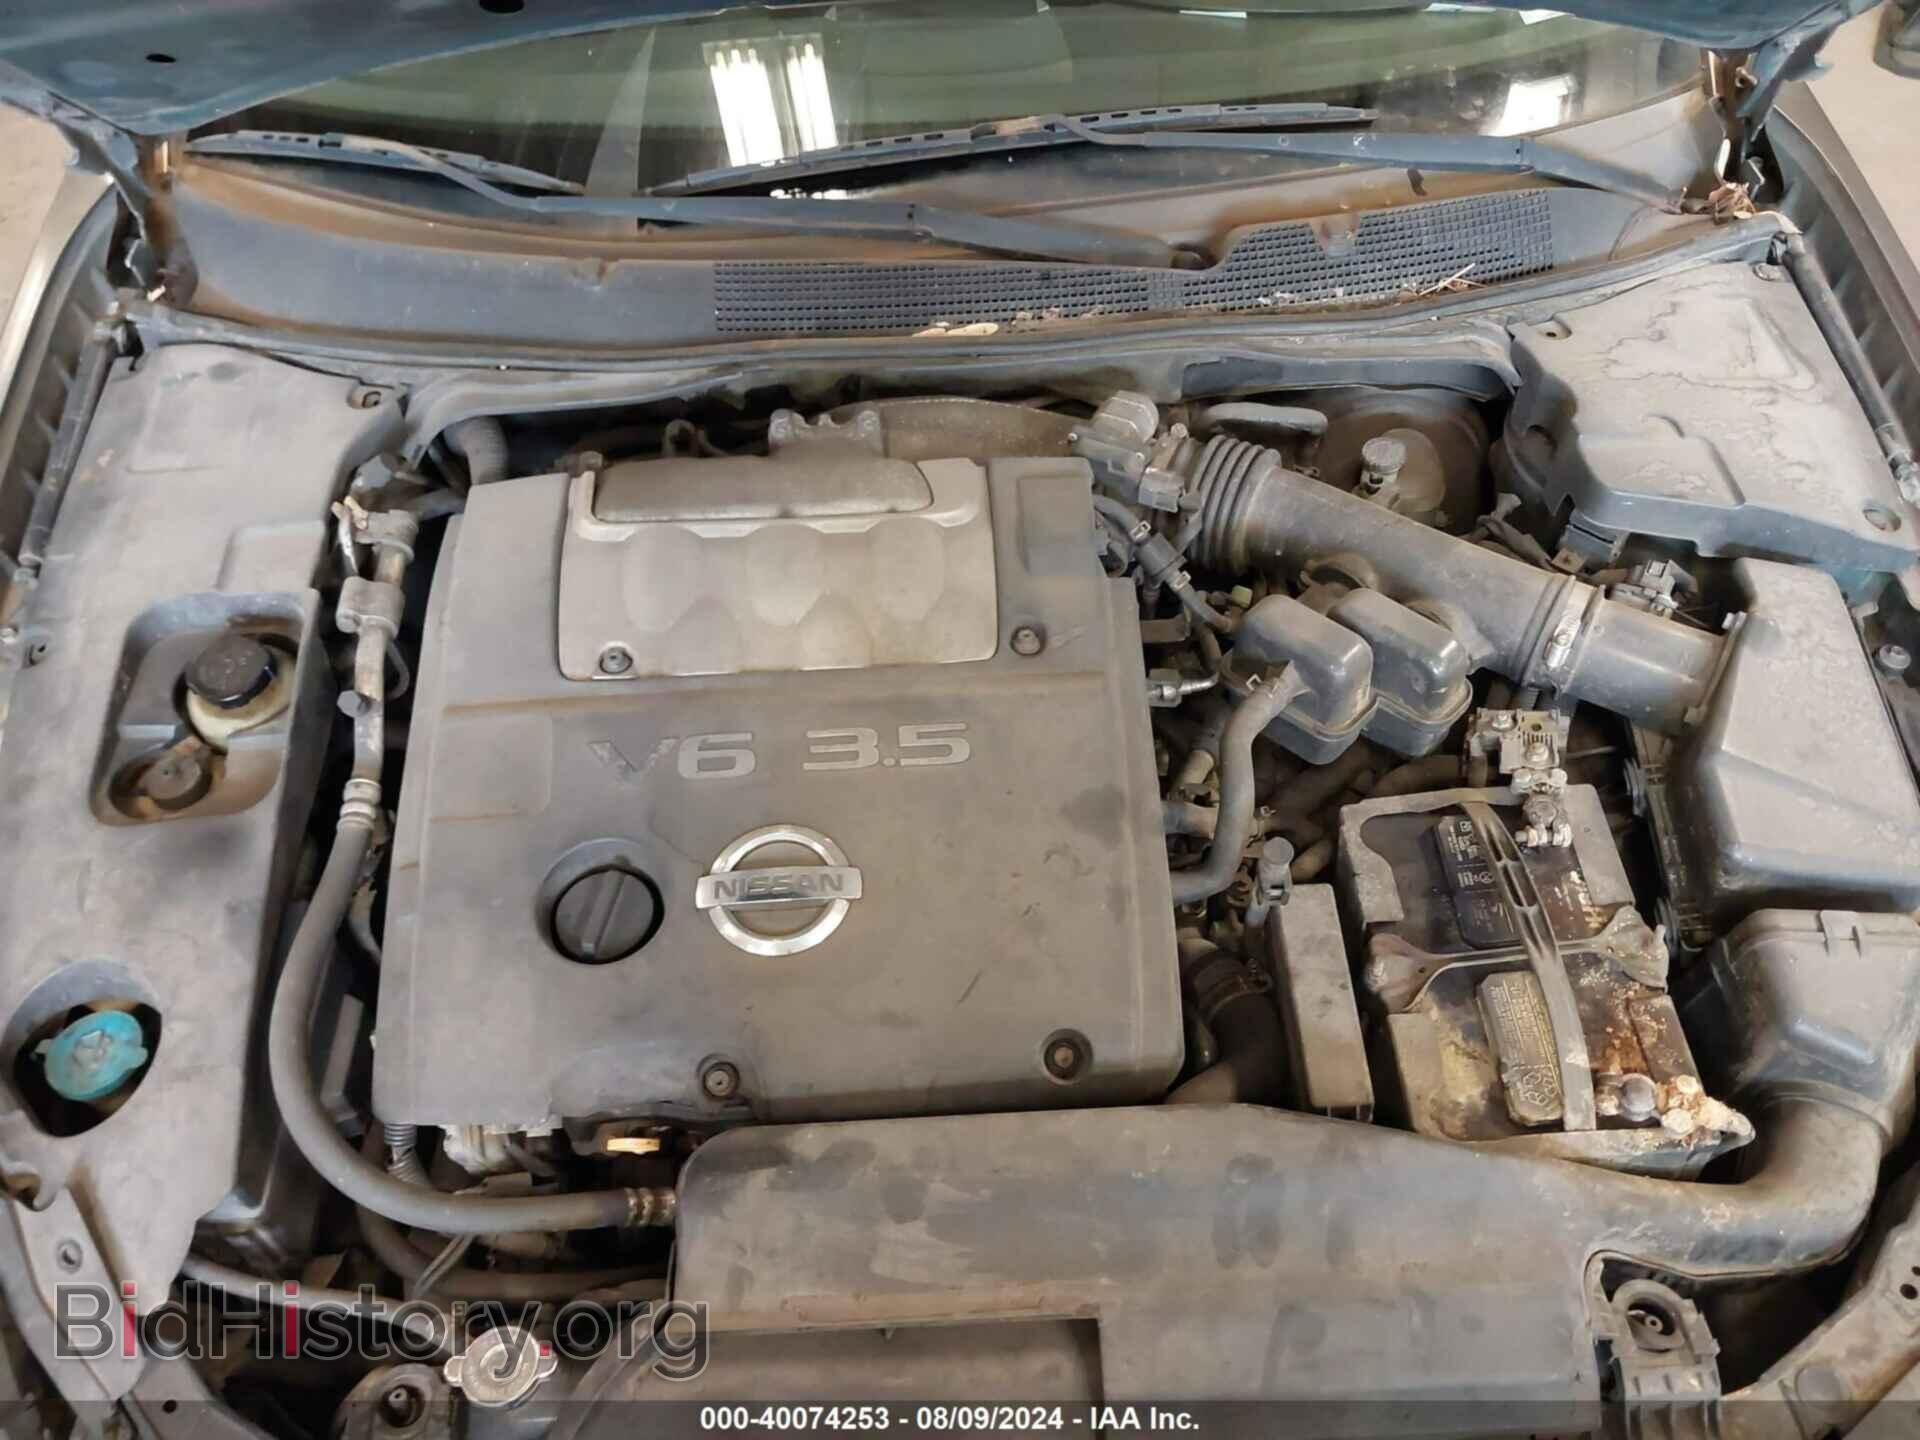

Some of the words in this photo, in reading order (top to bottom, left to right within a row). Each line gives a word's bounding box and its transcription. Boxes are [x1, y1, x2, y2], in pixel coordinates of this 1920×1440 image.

[588, 732, 756, 781] V6
[802, 722, 971, 771] 3.5
[712, 872, 844, 900] NISSAN
